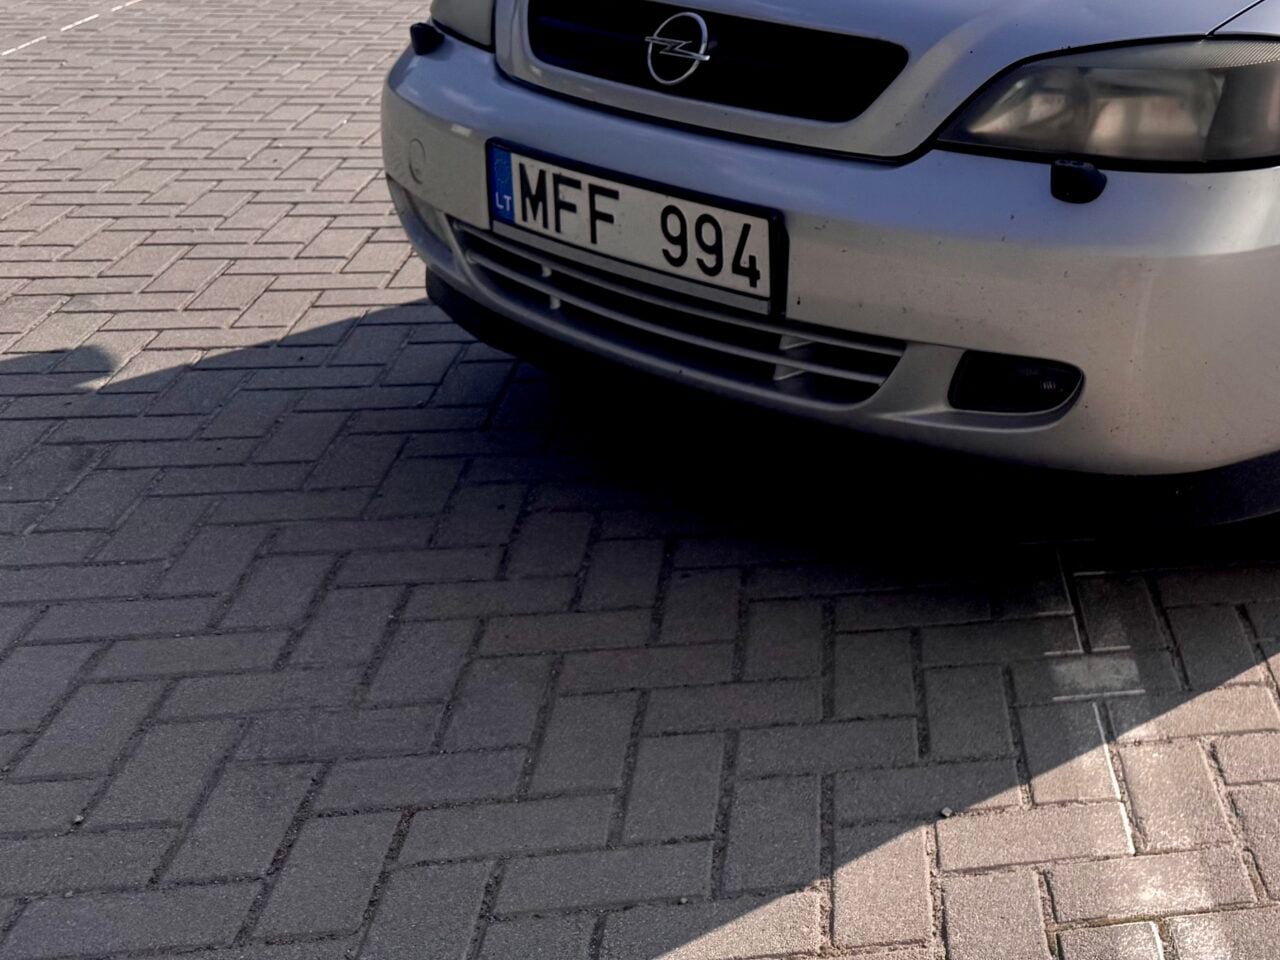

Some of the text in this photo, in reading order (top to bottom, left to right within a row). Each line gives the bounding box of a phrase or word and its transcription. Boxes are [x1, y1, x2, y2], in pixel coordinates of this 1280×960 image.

[495, 191, 513, 211] LT
[518, 162, 761, 288] MFF 994
